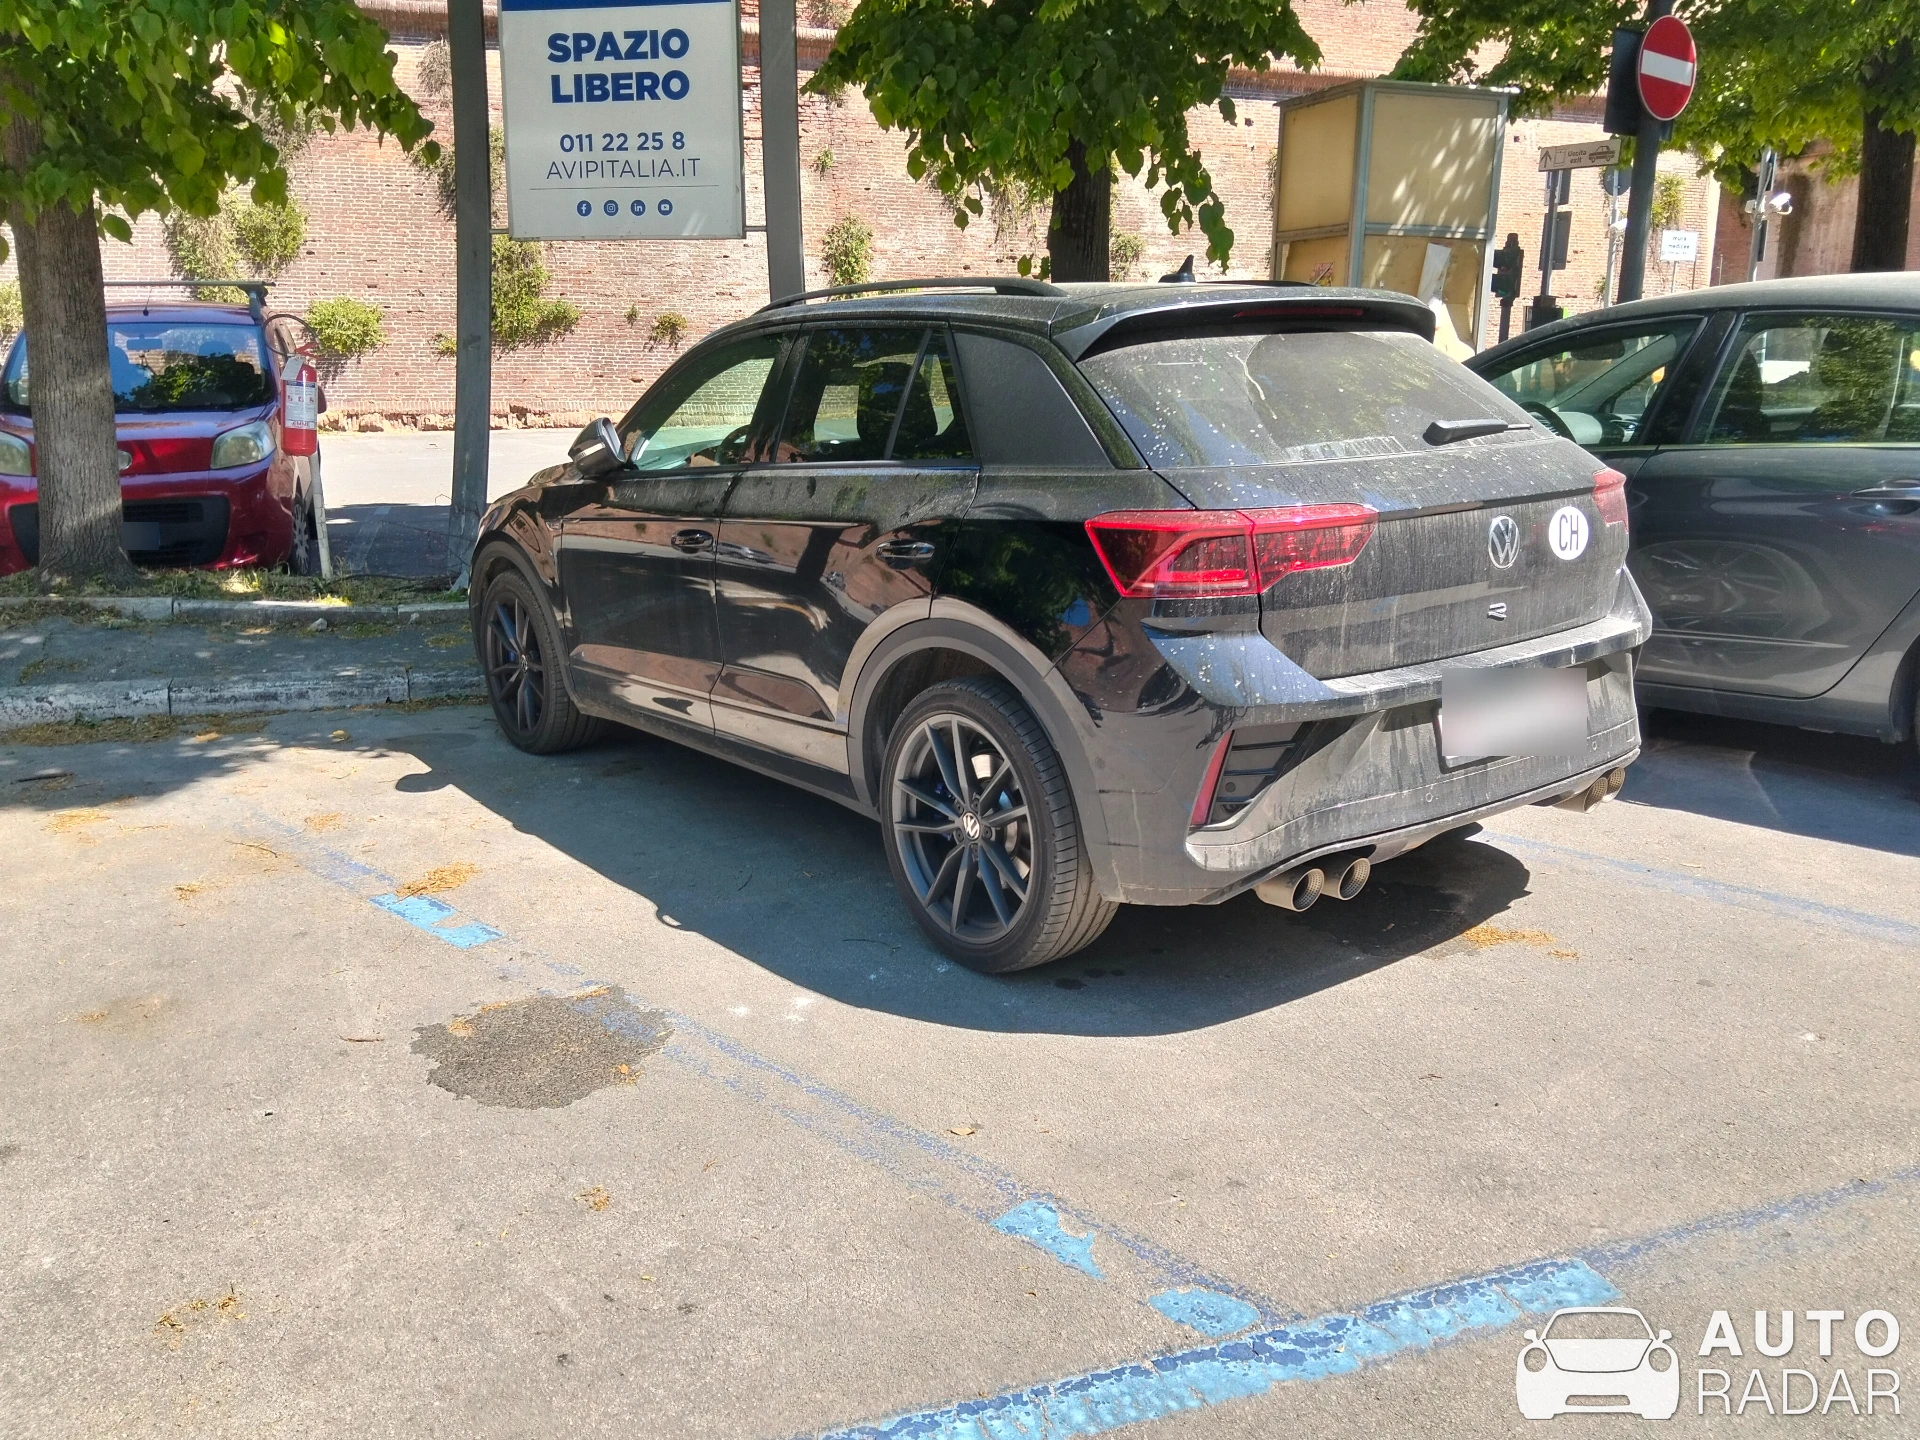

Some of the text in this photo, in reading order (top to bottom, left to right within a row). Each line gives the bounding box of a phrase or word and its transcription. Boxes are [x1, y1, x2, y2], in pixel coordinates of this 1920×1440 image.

[547, 28, 690, 63] SPAZIO
[551, 70, 690, 104] LIBERO
[560, 131, 685, 153] 011 22 25 8
[1567, 149, 1587, 157] Uscita
[546, 158, 700, 180] AVIPITALIA.IT
[1558, 514, 1579, 552] CH
